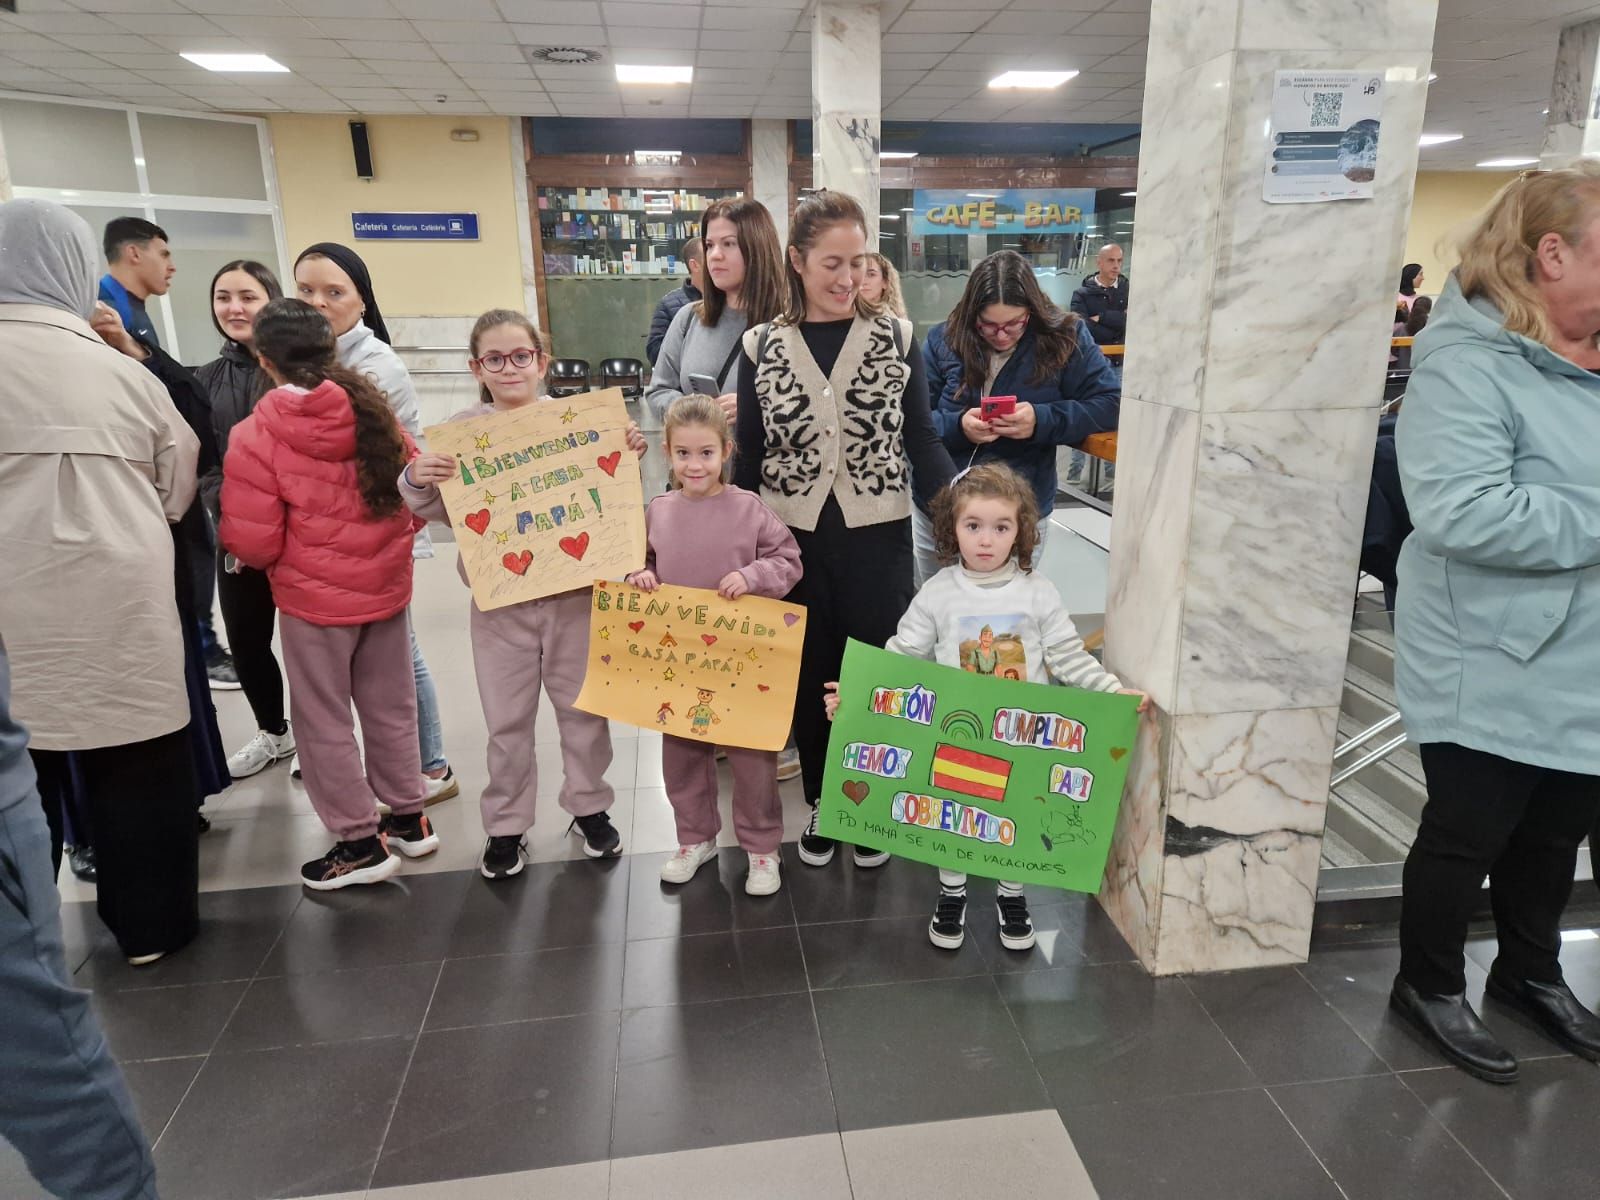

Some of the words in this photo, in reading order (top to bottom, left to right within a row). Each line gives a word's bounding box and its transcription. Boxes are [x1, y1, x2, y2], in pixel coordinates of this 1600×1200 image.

[927, 199, 996, 229] CAFÉ
[1024, 202, 1082, 228] BAR
[511, 482, 527, 502] A
[530, 464, 584, 494] CASA
[628, 643, 678, 663] CASA
[874, 685, 935, 723] MISIÓN
[994, 709, 1083, 752] CUMPLIDA
[844, 744, 909, 778] HEMOS
[1052, 766, 1091, 798] PAPI
[836, 810, 857, 828] PD
[905, 833, 922, 847] SE
[932, 841, 947, 854] VA
[956, 848, 975, 860] DE
[892, 794, 1014, 845] SOBREVIVIDO
